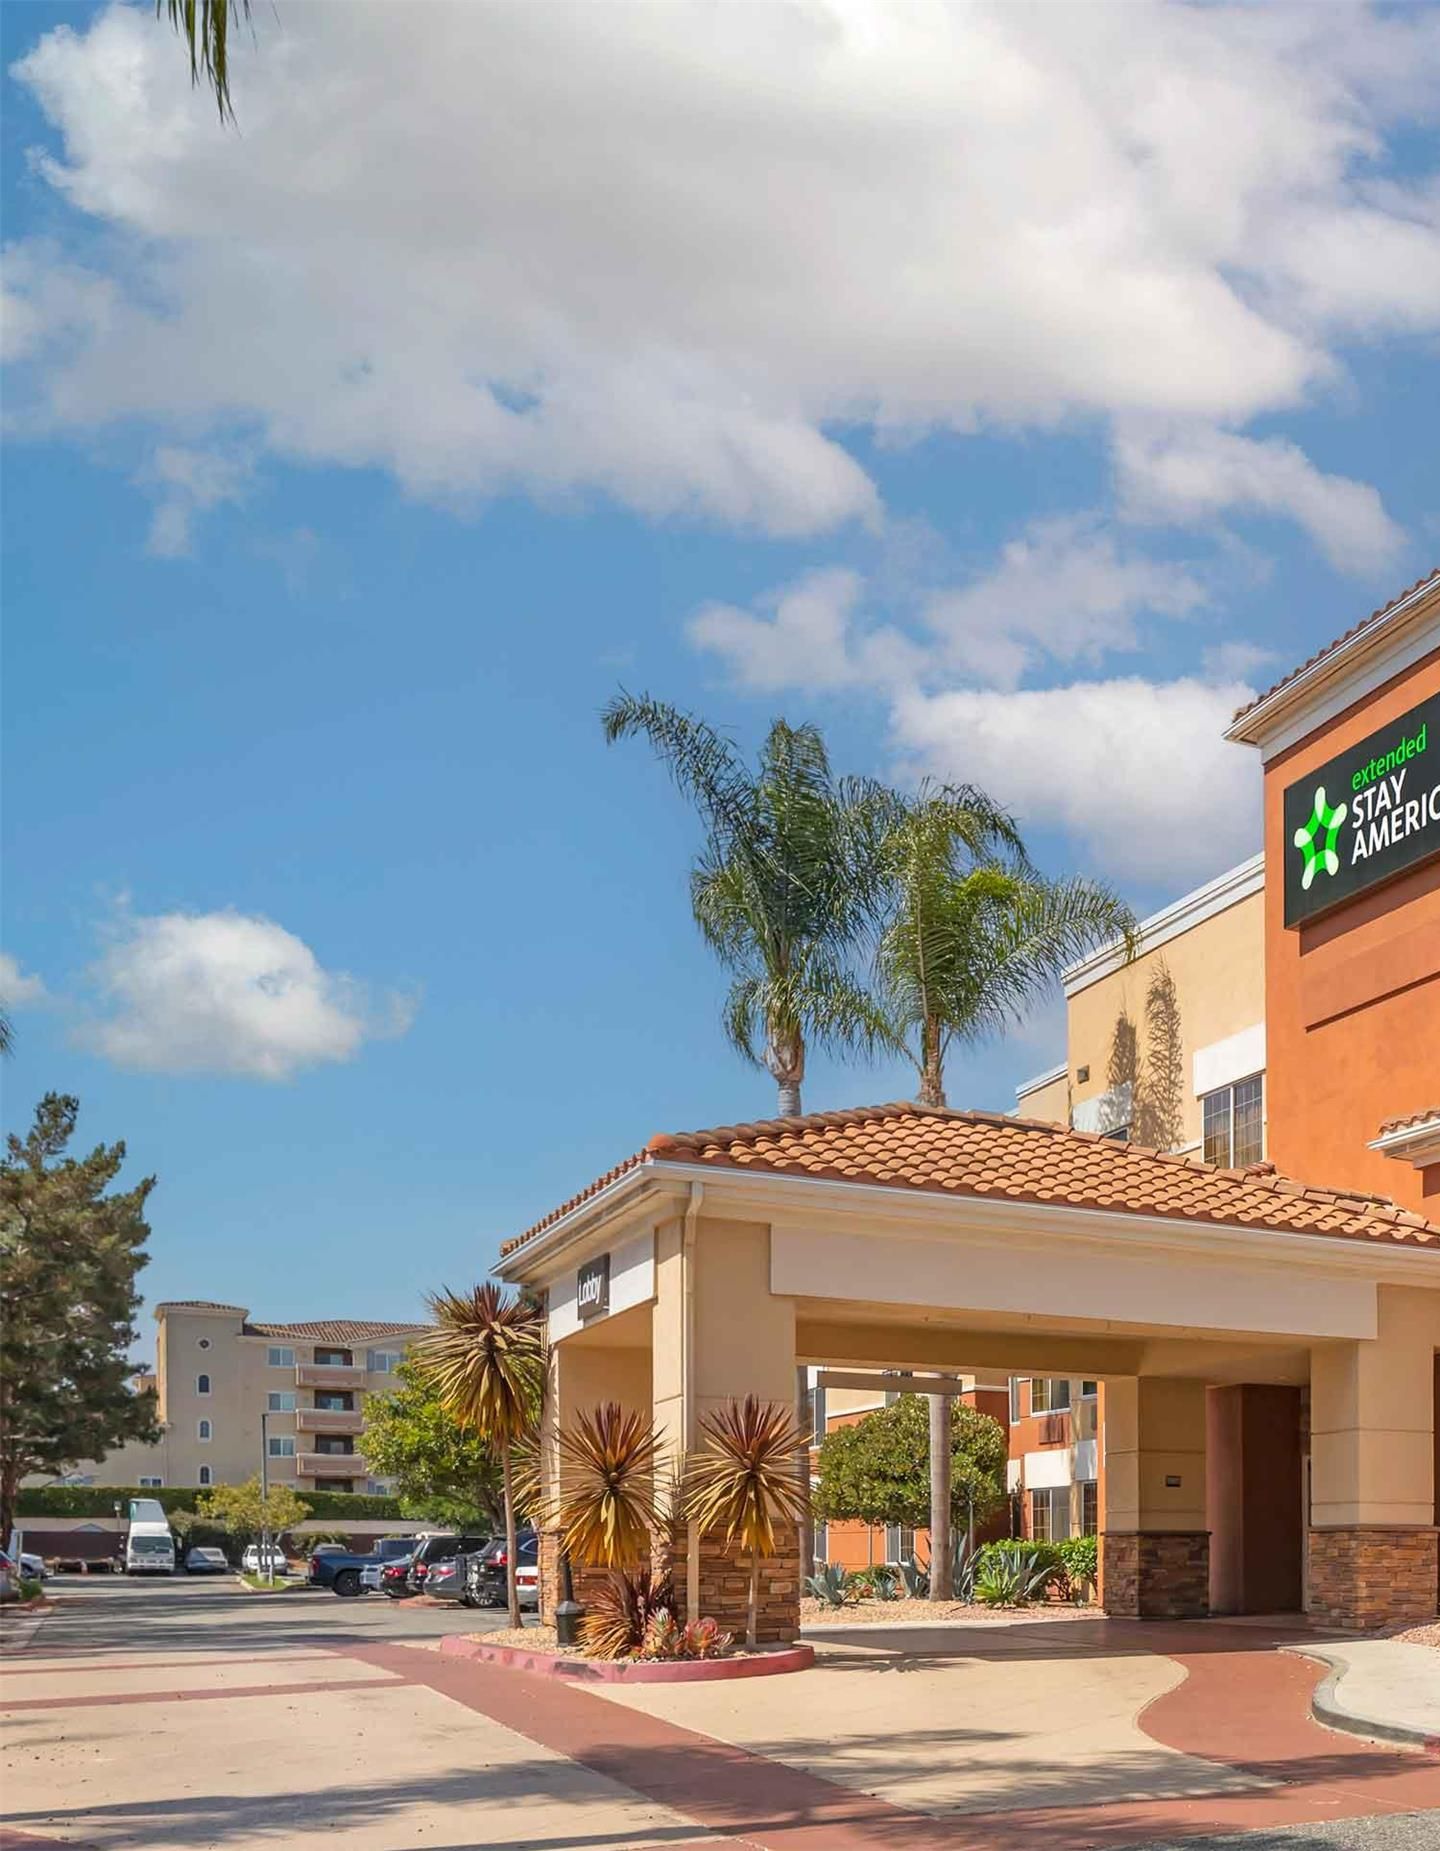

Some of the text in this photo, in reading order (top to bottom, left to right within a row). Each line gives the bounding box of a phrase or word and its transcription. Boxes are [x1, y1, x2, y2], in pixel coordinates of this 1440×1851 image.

[1352, 724, 1427, 790] extended
[1352, 768, 1407, 829] STAY
[578, 1272, 602, 1306] Lobby
